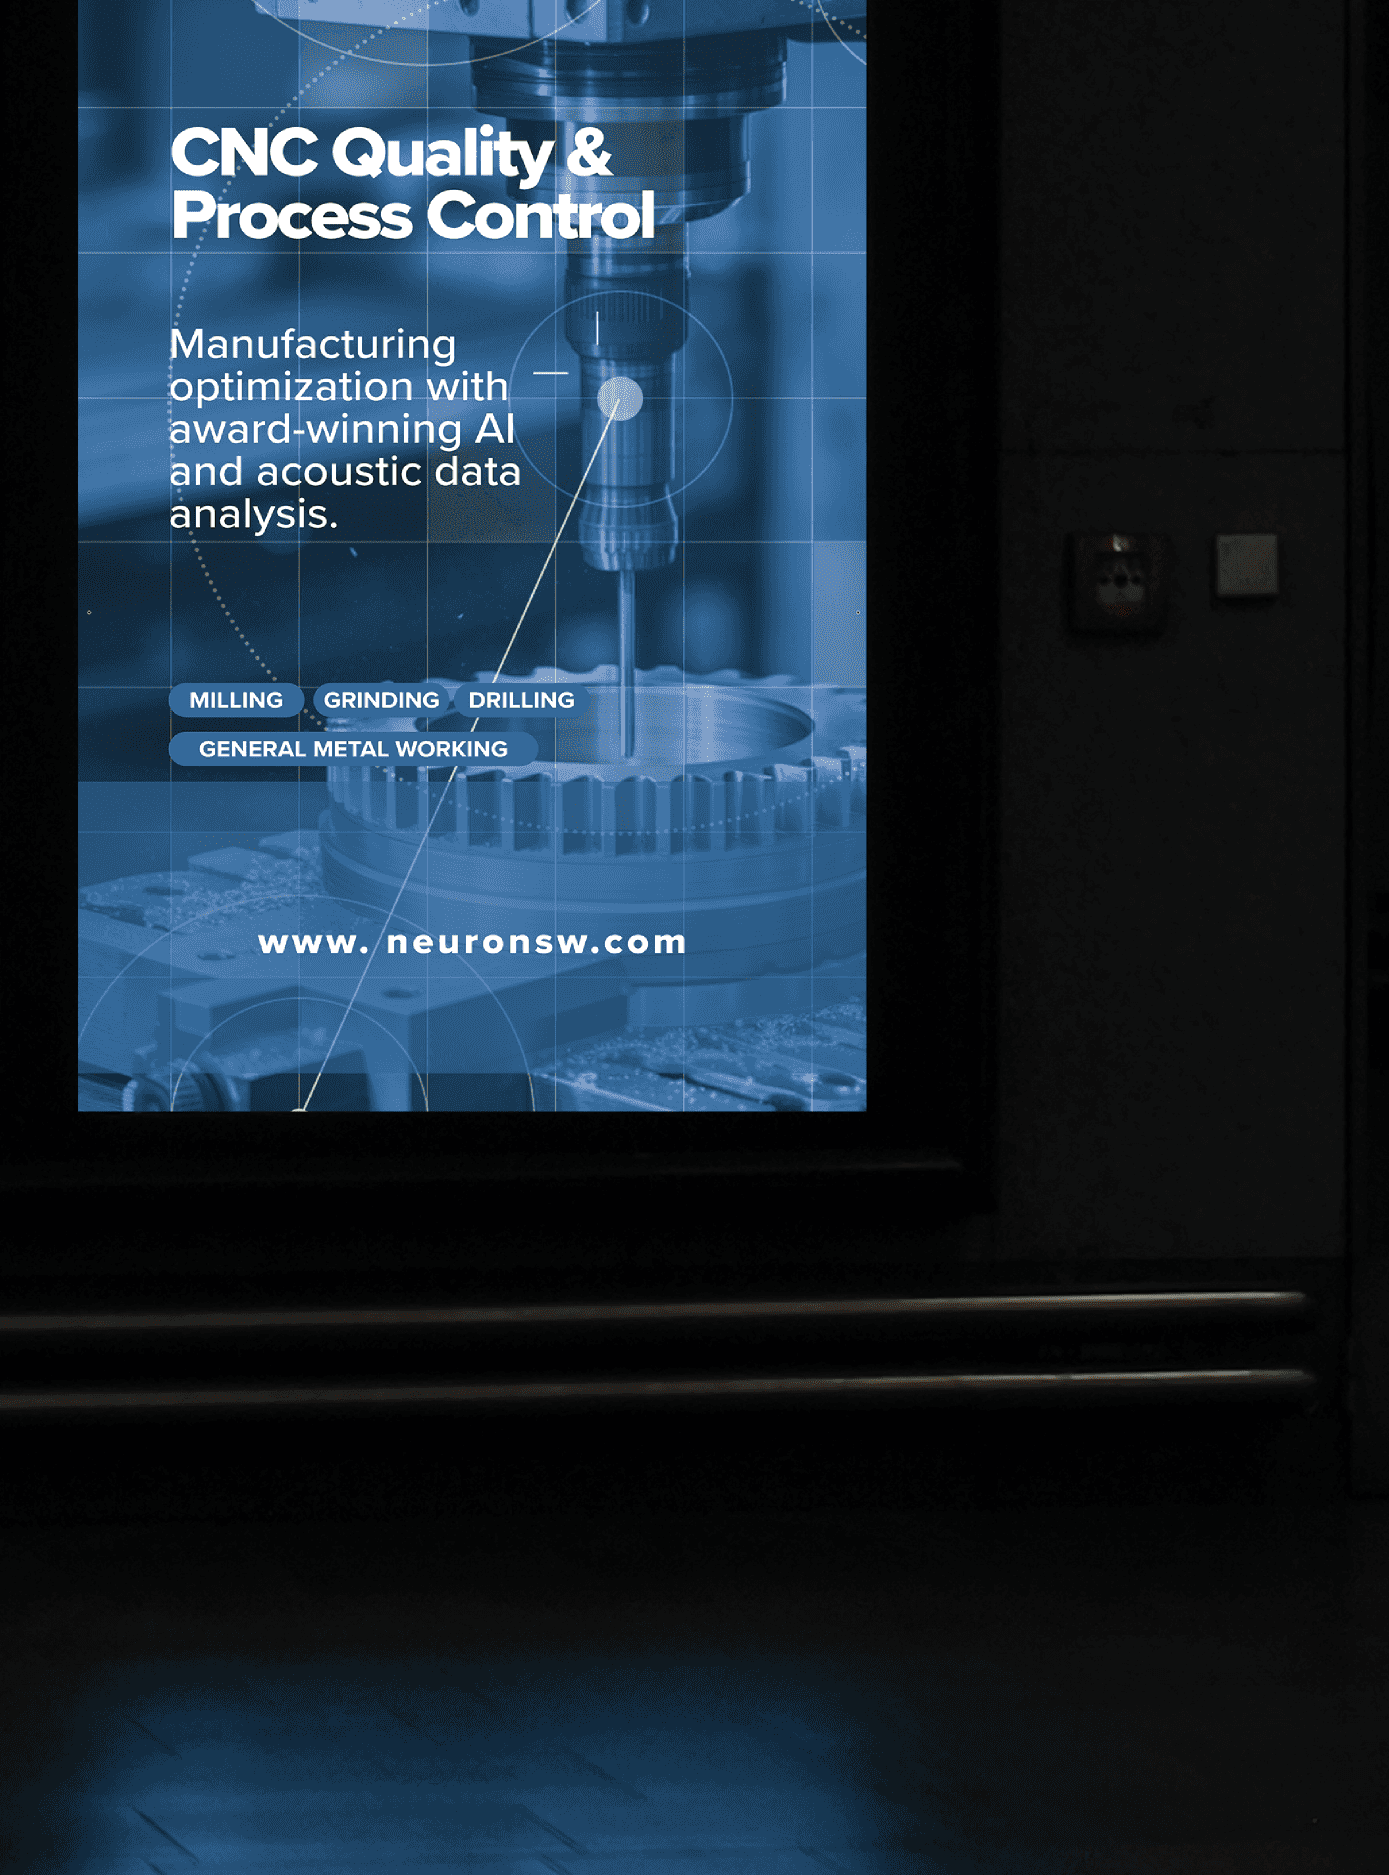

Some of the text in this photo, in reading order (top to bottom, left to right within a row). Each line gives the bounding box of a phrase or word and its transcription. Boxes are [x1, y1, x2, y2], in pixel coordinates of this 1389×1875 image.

[171, 123, 614, 189] CNC Quality &
[174, 189, 655, 239] Process Control
[171, 327, 455, 367] Manufacturing
[170, 370, 508, 409] optimization with
[170, 412, 514, 452] award-winning AI
[170, 455, 520, 486] and acoustic data
[170, 497, 337, 537] analysis.
[190, 691, 575, 709] MILLING GRINDING DRILLING
[199, 740, 508, 758] GENERAL METAL WORKING
[257, 934, 685, 954] www. neuronsw.com
